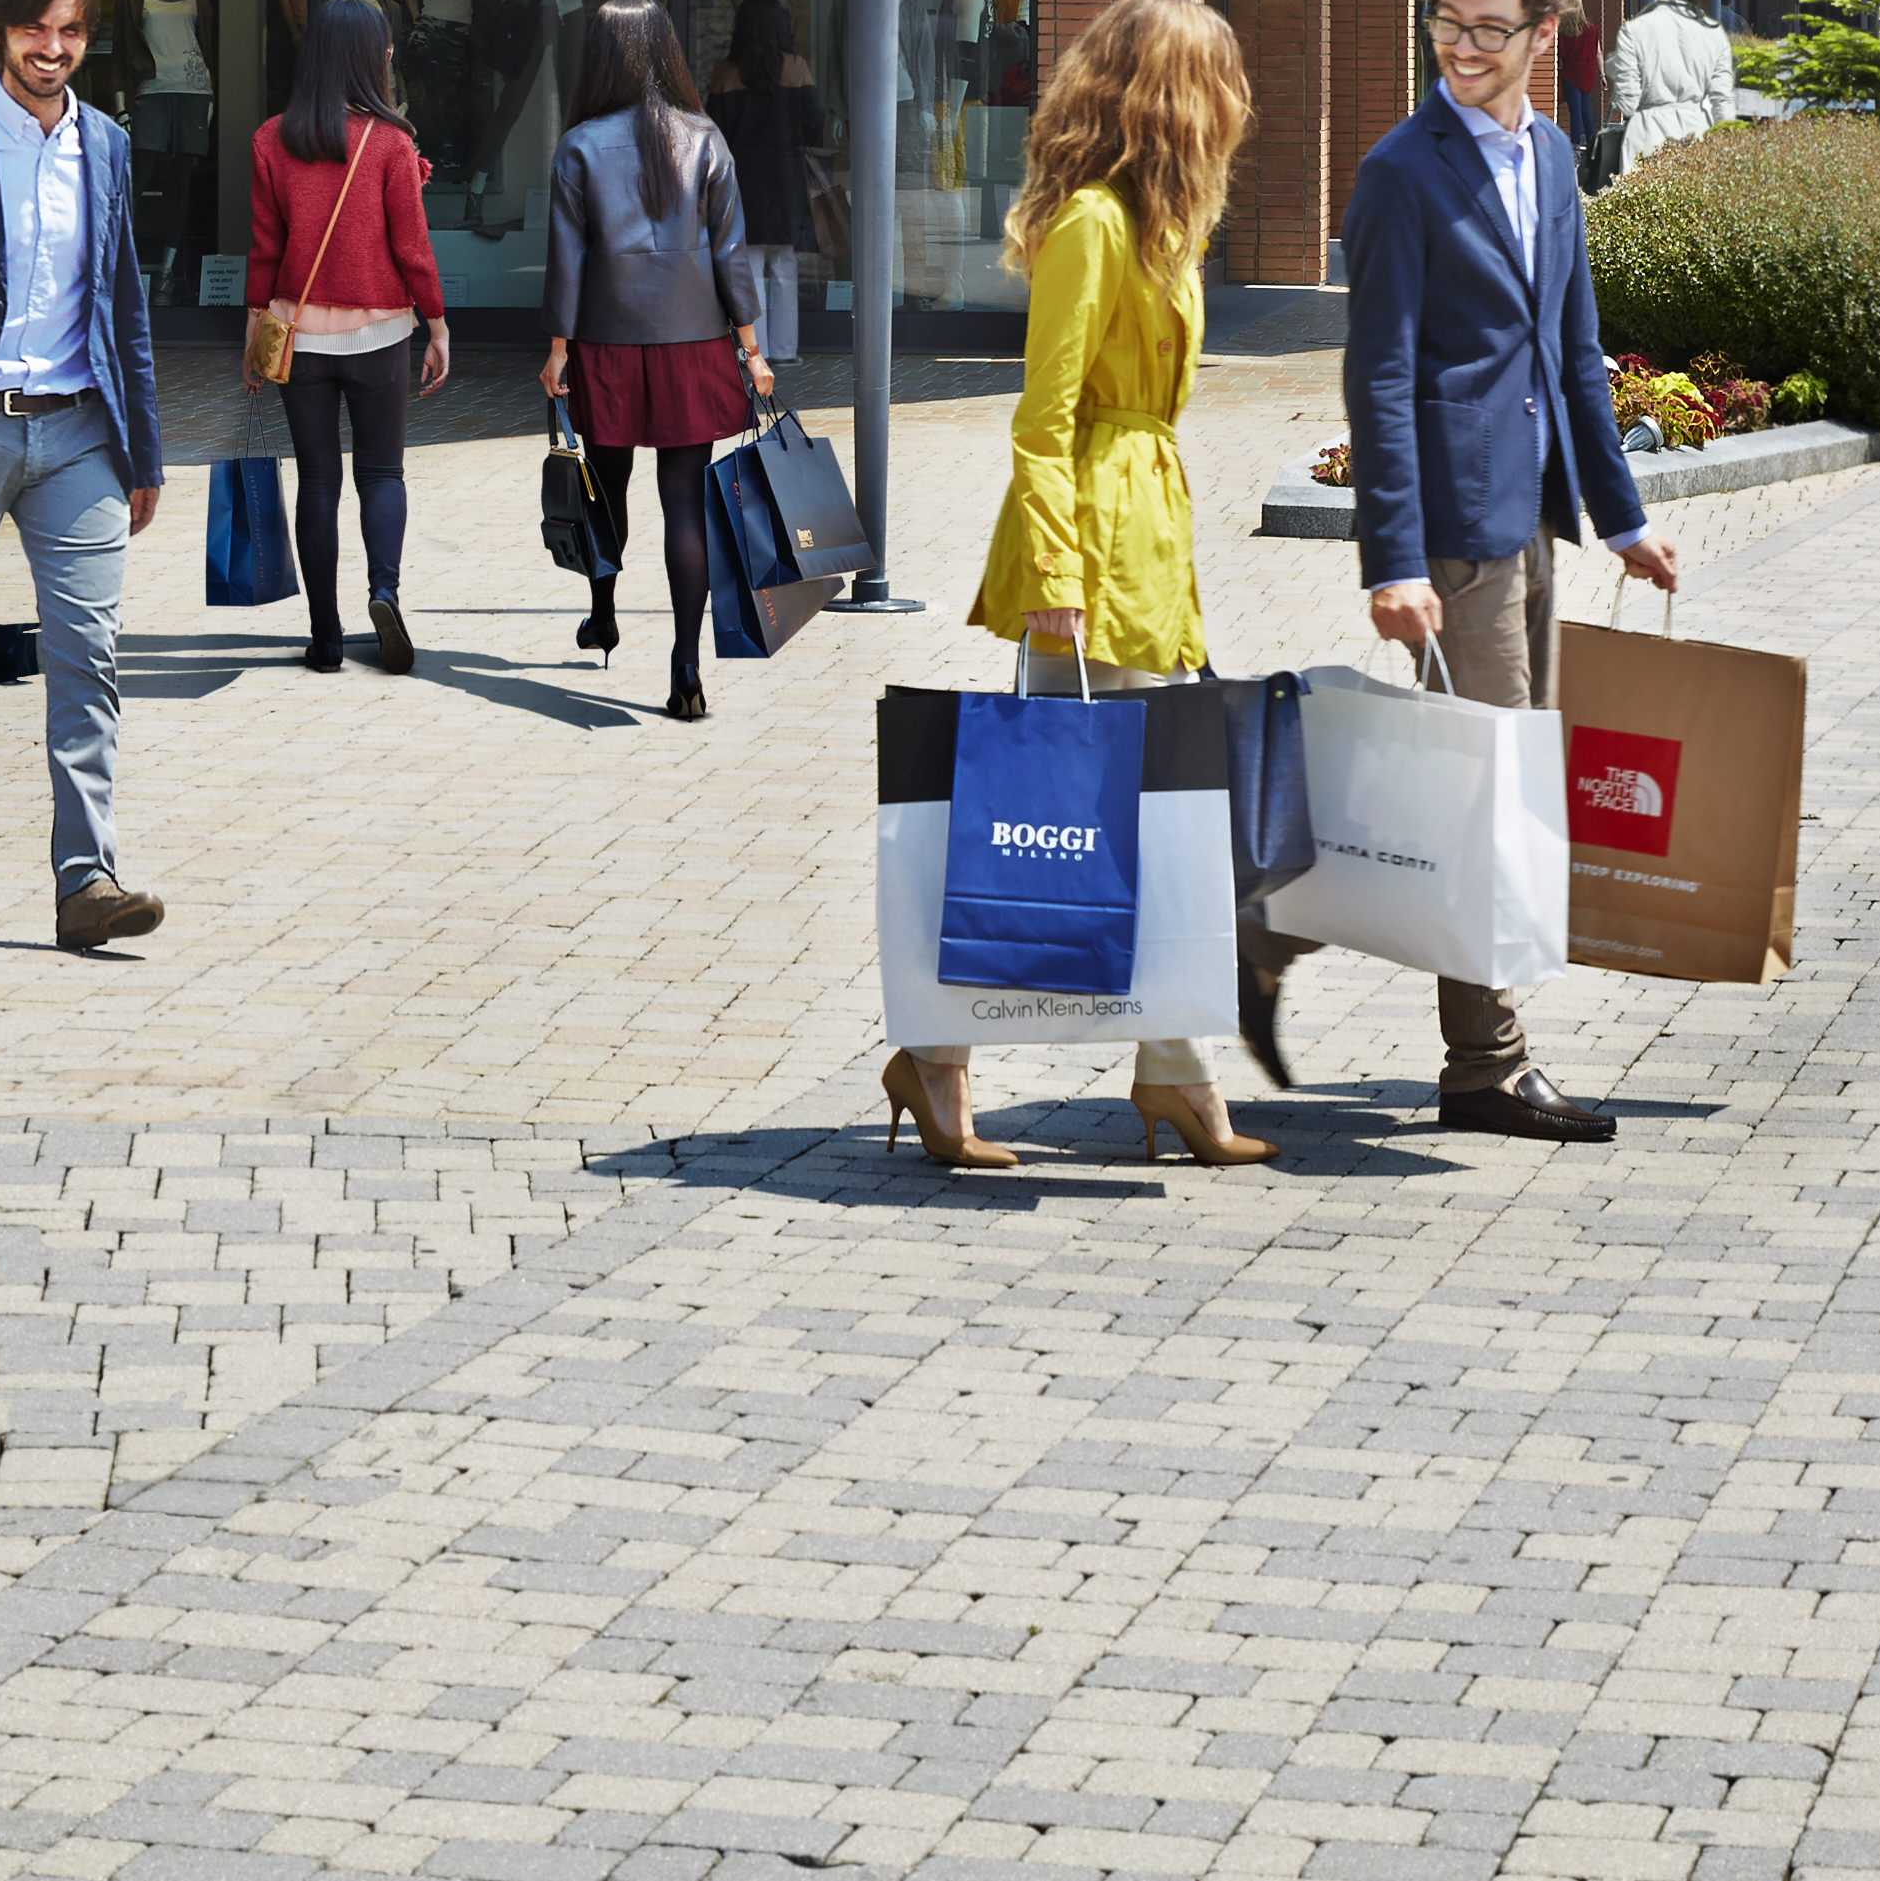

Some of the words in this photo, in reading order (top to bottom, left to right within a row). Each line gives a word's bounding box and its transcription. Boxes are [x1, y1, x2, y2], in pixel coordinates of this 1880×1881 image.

[1606, 766, 1637, 785] THE
[1577, 776, 1637, 799] NORTH
[1591, 796, 1633, 813] FACE
[990, 822, 1096, 852] BOGGI
[1001, 848, 1083, 862] MILANO
[1376, 851, 1437, 872] CONTI
[1613, 869, 1699, 893] EXPLORING
[971, 998, 1033, 1020] Calvin
[1036, 996, 1083, 1017] Klein
[1085, 994, 1143, 1015] Jeans
